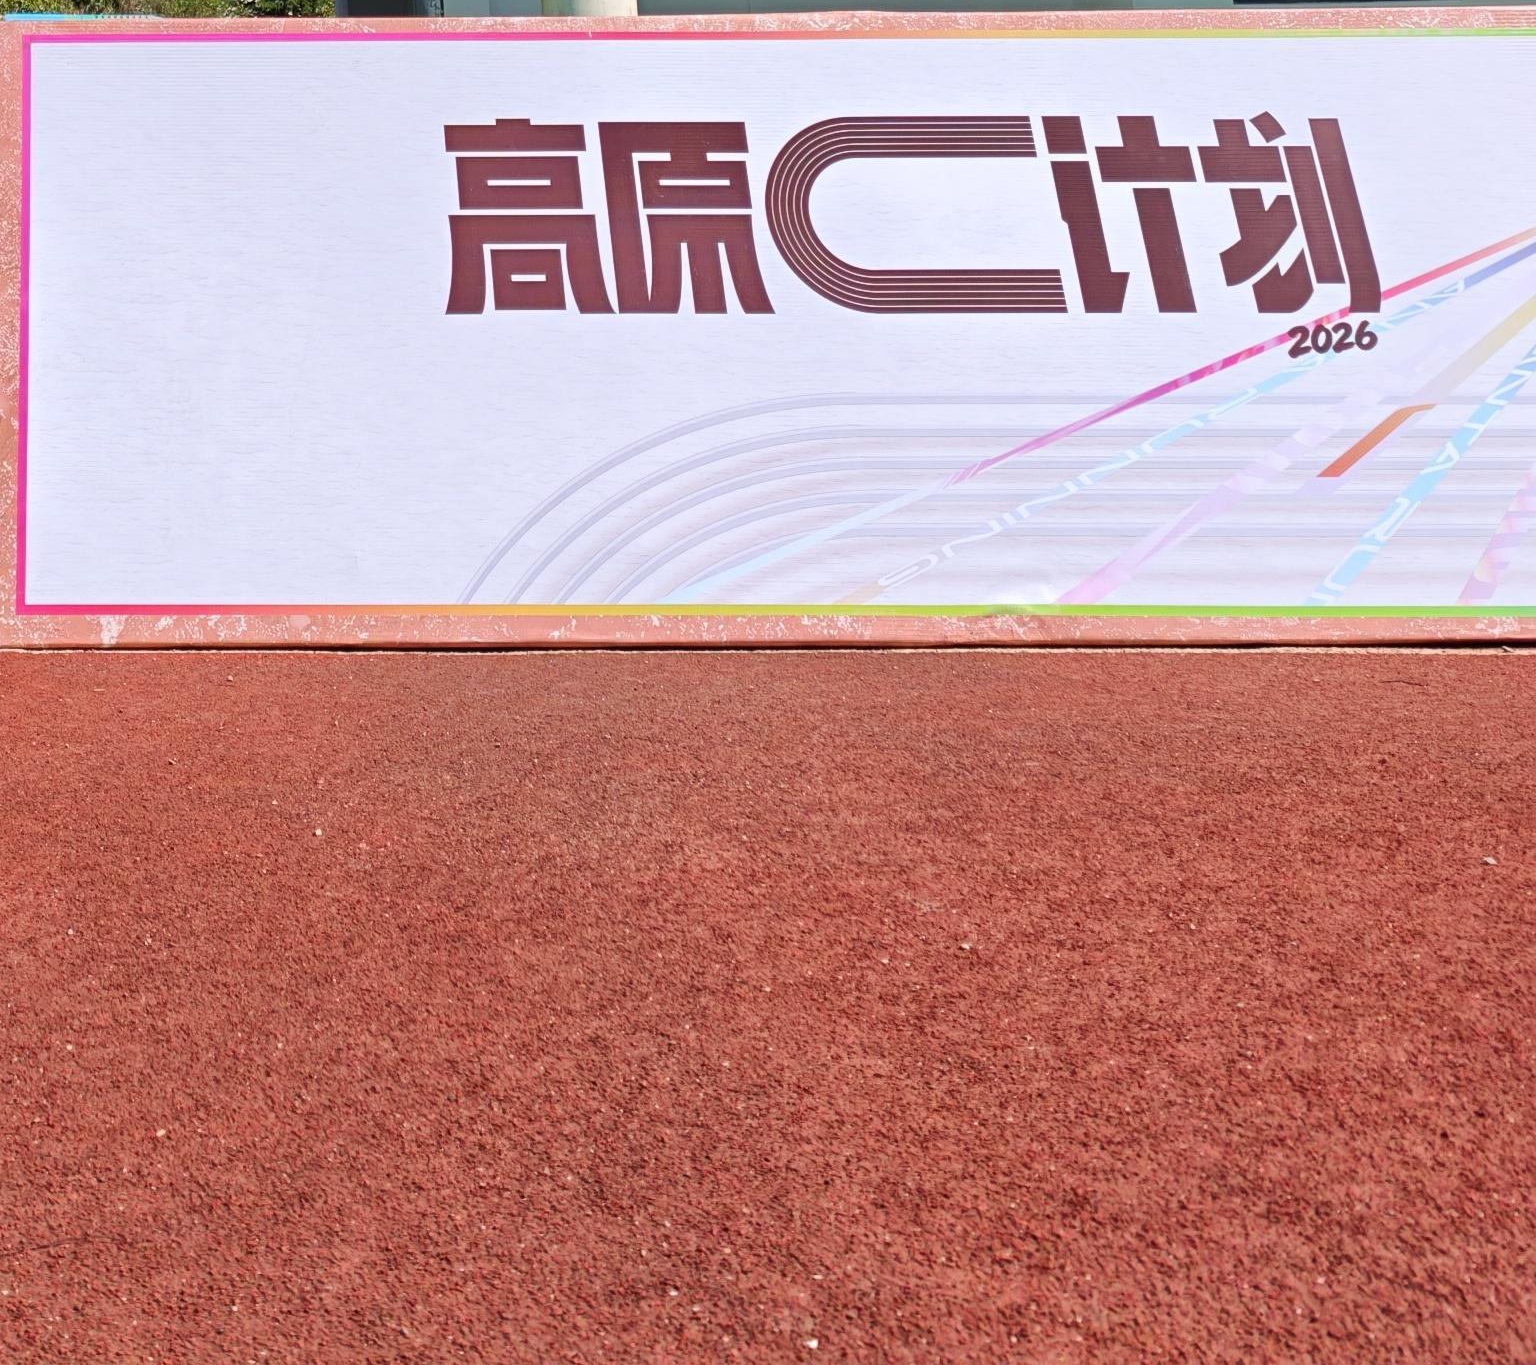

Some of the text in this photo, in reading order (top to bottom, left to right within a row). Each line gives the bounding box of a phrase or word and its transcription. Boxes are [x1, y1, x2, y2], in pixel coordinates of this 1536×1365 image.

[443, 110, 1382, 315] 高原C计划
[1287, 319, 1379, 359] 2026
